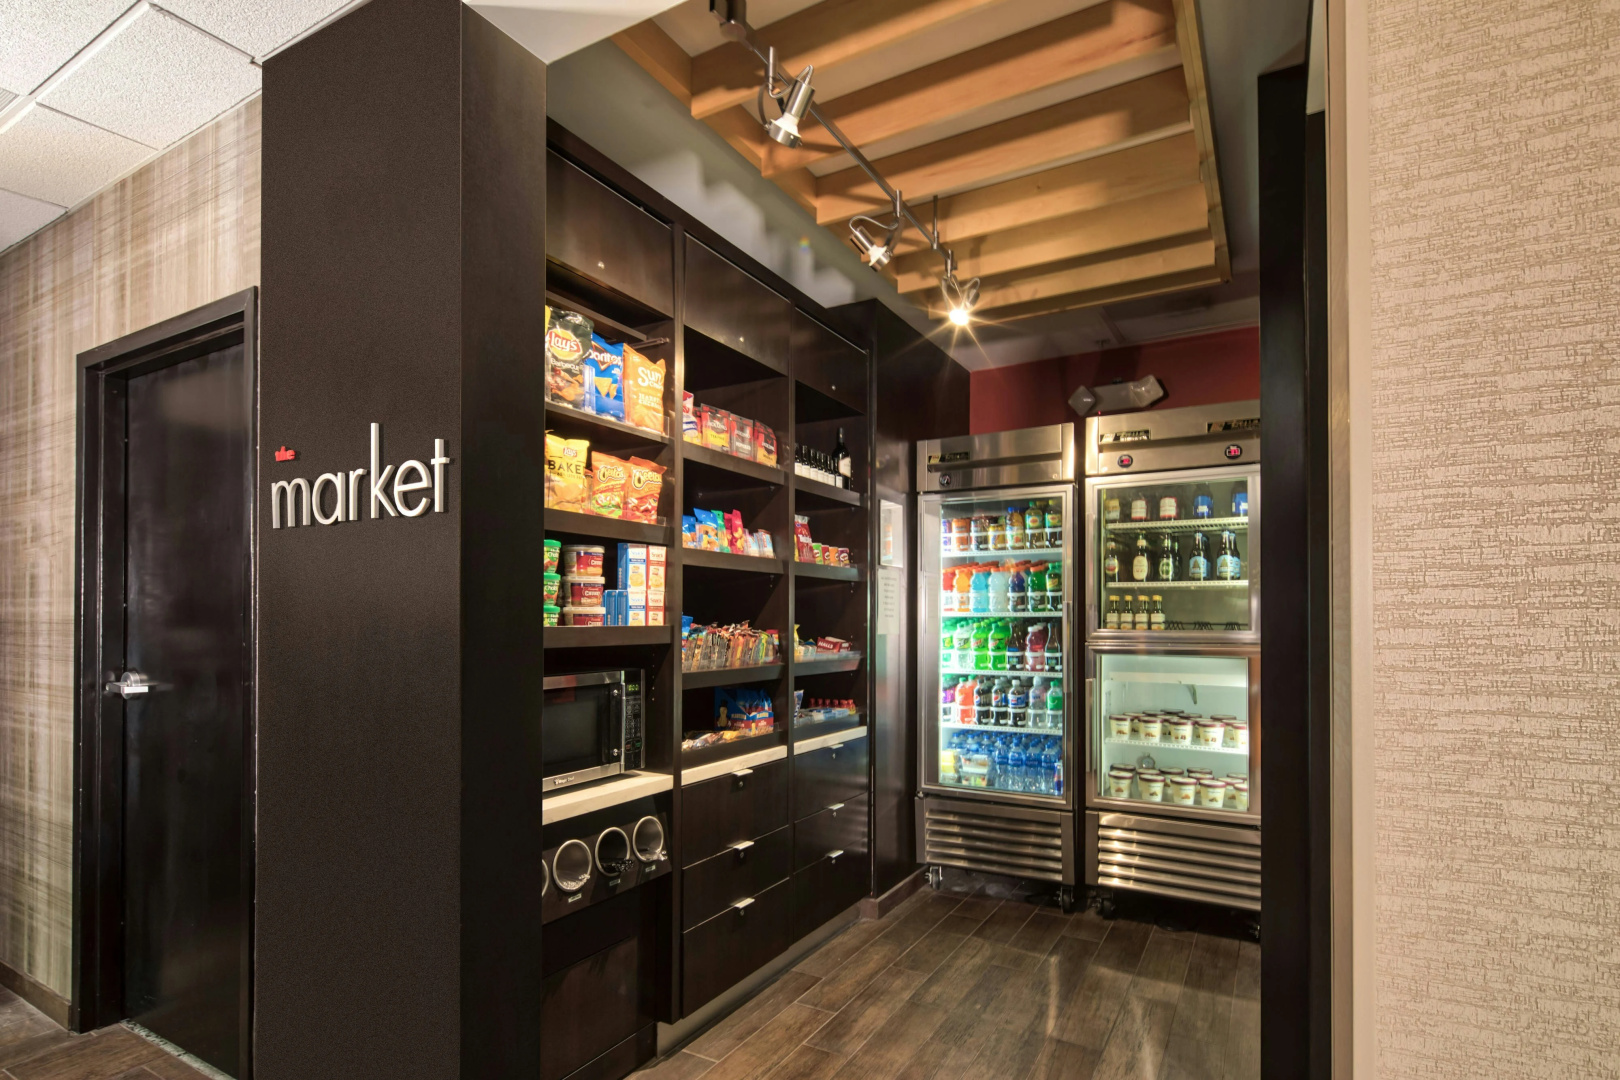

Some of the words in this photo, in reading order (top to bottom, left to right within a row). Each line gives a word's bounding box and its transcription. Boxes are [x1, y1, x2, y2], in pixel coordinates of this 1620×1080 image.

[550, 331, 577, 352] Lay's
[271, 423, 450, 529] market
[548, 459, 583, 475] BAKE
